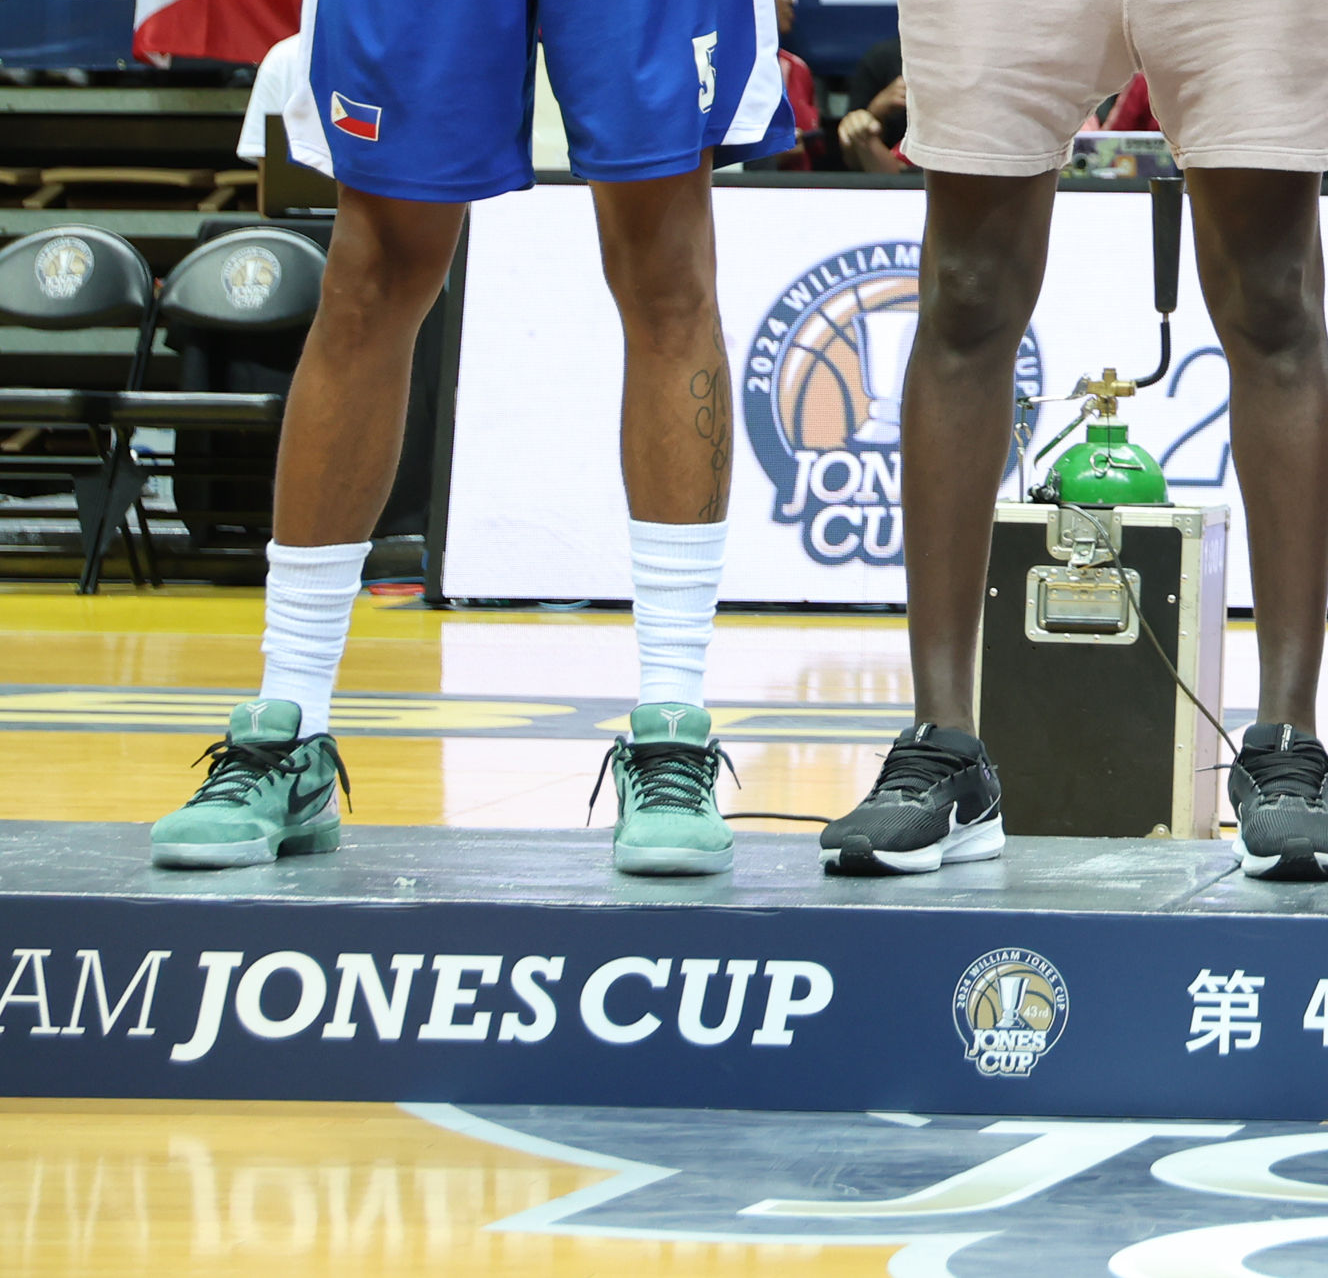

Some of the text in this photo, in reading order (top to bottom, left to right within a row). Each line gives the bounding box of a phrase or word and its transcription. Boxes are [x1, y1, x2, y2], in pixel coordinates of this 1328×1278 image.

[691, 30, 719, 115] 5
[748, 316, 789, 394] 2024
[782, 244, 921, 313] WILLIAM
[782, 450, 902, 517] JON
[811, 504, 904, 559] CU
[170, 949, 567, 1064] JONES
[580, 956, 835, 1048] CUP
[957, 951, 1066, 1011] 2024 WILLIAM JONES CUP
[1023, 1004, 1050, 1019] 43rd
[968, 1028, 1047, 1057] JONES
[979, 1050, 1034, 1074] CUP
